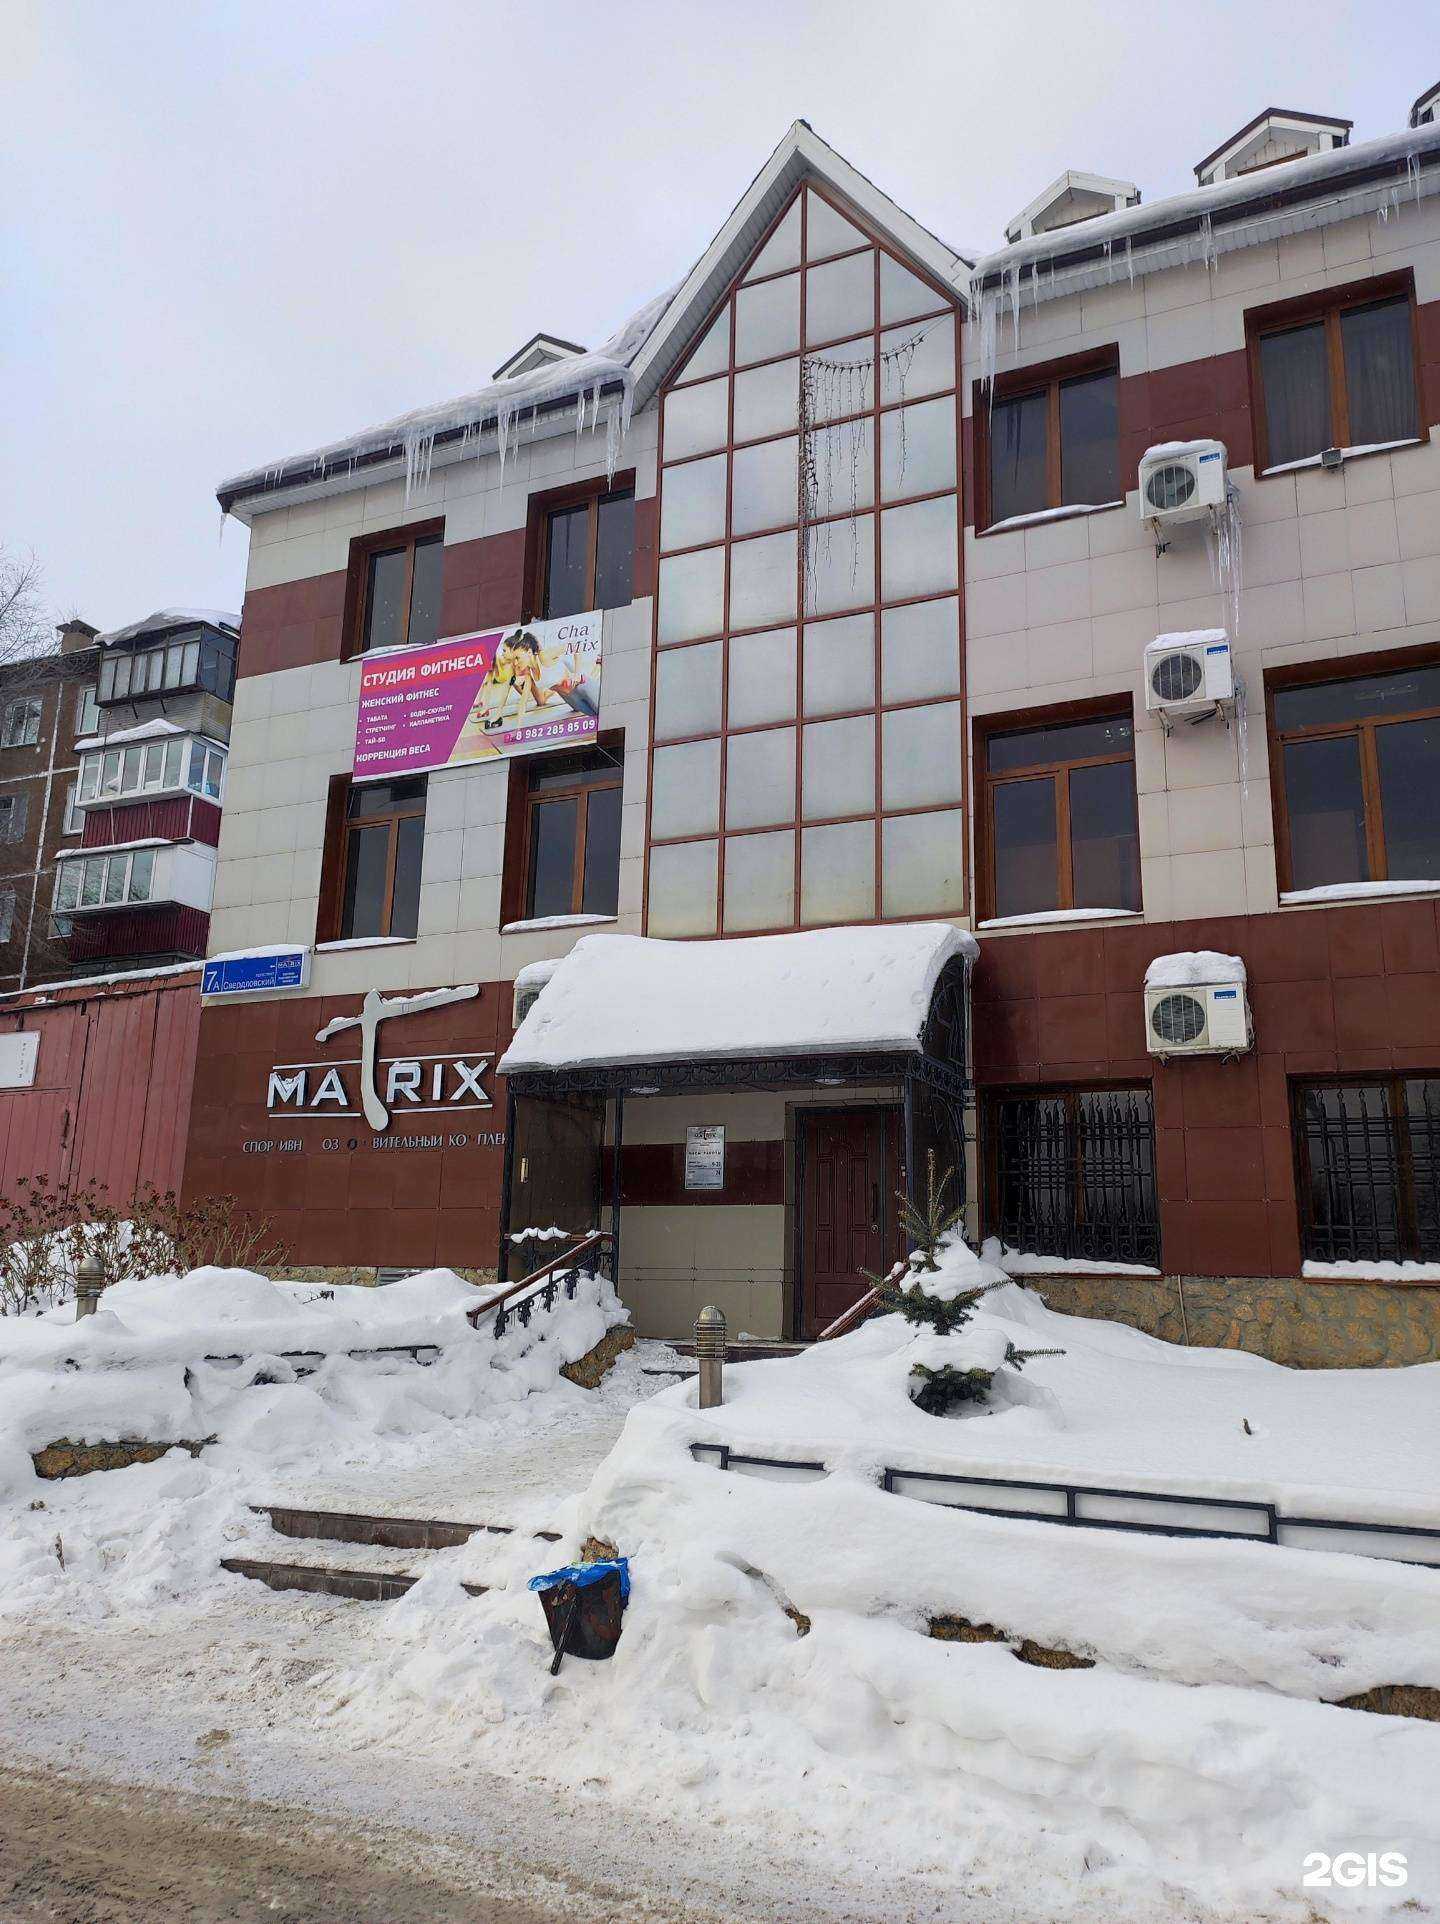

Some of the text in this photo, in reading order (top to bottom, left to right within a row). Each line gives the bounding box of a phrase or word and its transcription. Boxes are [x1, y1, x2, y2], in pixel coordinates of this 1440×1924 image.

[558, 624, 589, 640] Cha
[565, 639, 599, 655] Mix
[363, 653, 484, 687] СТУДИЯ ФИТНЕСА
[361, 688, 440, 709] ЖЕНСКИЙ ФИТНЕС
[365, 723, 397, 734] СТРЕТЧИНГ
[515, 719, 596, 741] 8 982 285 85 09
[356, 743, 431, 763] КОРРЕКЦИЯ ВЕСА
[223, 976, 276, 990] Свердловский
[266, 984, 490, 1132] MATRIX
